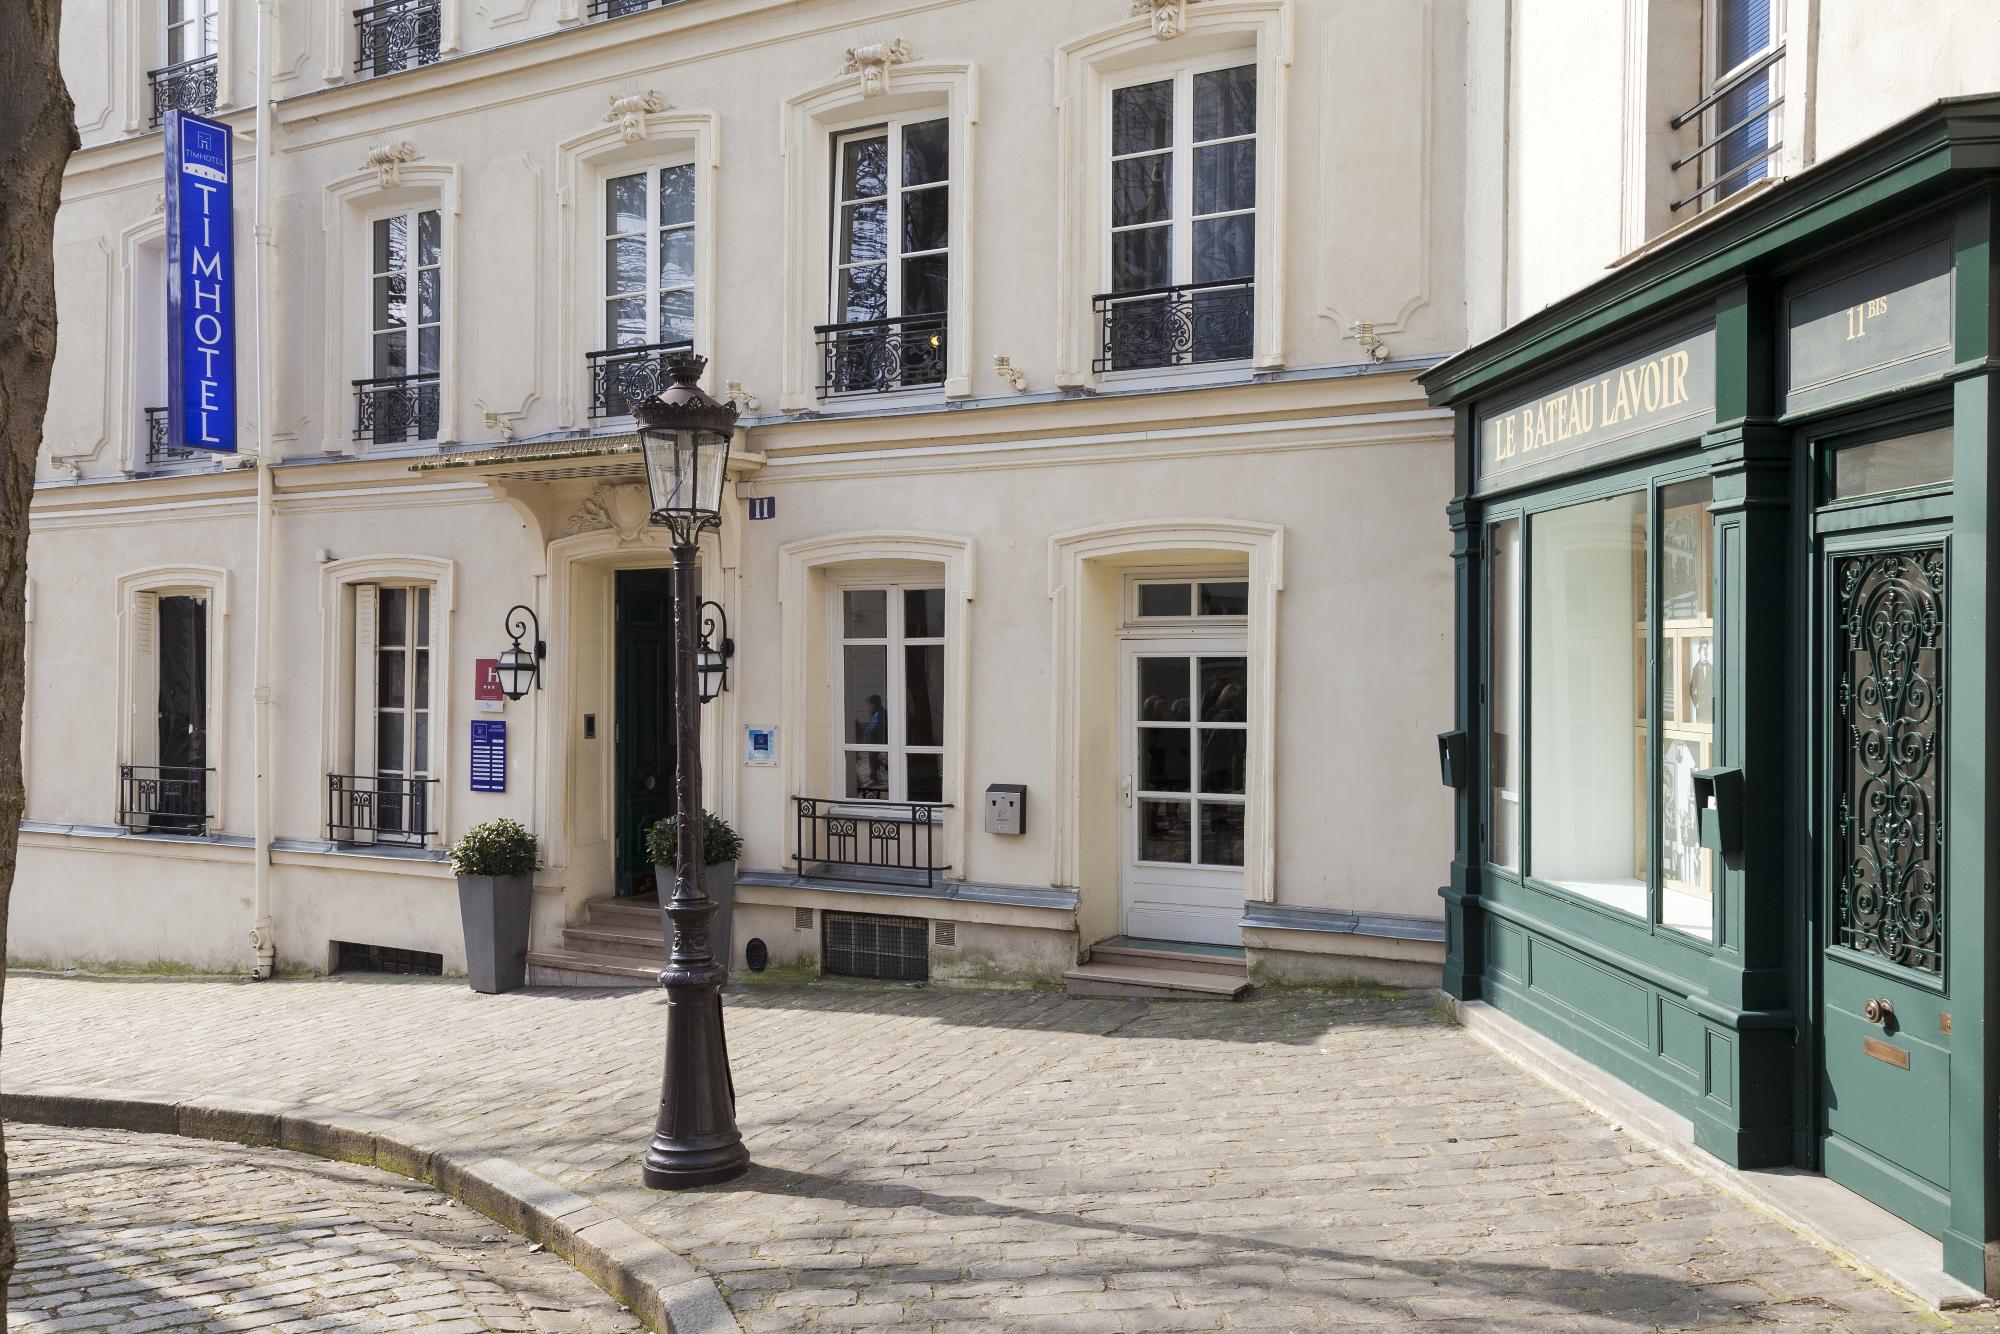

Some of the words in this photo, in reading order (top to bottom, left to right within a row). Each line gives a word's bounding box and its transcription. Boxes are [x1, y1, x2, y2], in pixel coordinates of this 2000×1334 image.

[185, 148, 224, 166] TIMHOTEL
[191, 182, 223, 443] TIMHOTEL
[1494, 415, 1516, 461] LE
[1522, 386, 1595, 453] BATEAU
[1600, 351, 1689, 428] LAVOIR
[755, 499, 768, 518] 11
